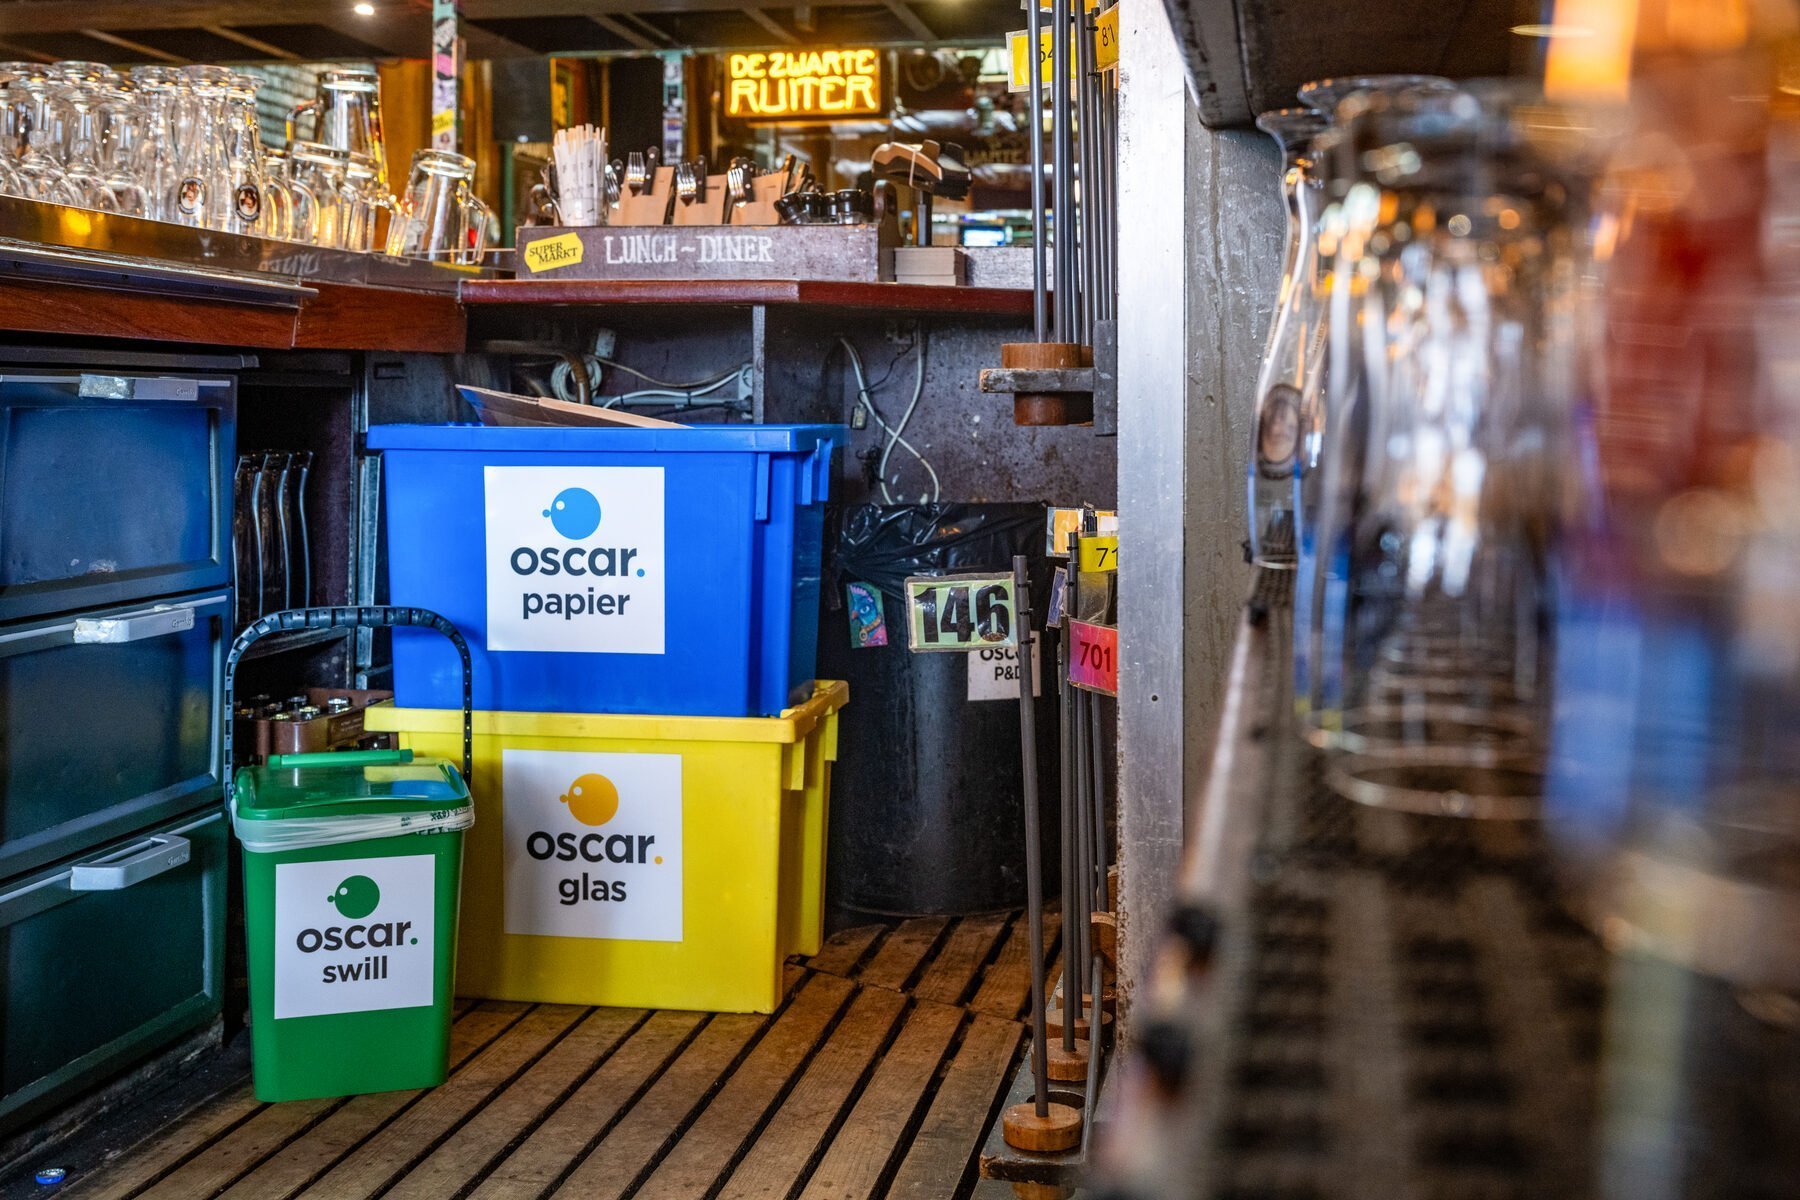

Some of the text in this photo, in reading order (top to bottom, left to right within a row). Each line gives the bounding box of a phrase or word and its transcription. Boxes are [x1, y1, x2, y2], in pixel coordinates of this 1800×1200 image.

[730, 49, 876, 78] DE ZWARTE
[729, 75, 876, 114] RUITER
[529, 242, 563, 256] SUPER
[539, 247, 578, 264] MARKT
[604, 235, 678, 264] LUNCH
[696, 235, 775, 263] DINER
[510, 547, 646, 577] oscar.
[523, 587, 631, 620] papier
[914, 585, 1010, 643] 146
[1080, 640, 1111, 673] 701
[526, 830, 663, 865] oscar.
[558, 872, 627, 906] glas
[296, 920, 419, 953] oscar.
[322, 955, 388, 984] swill
